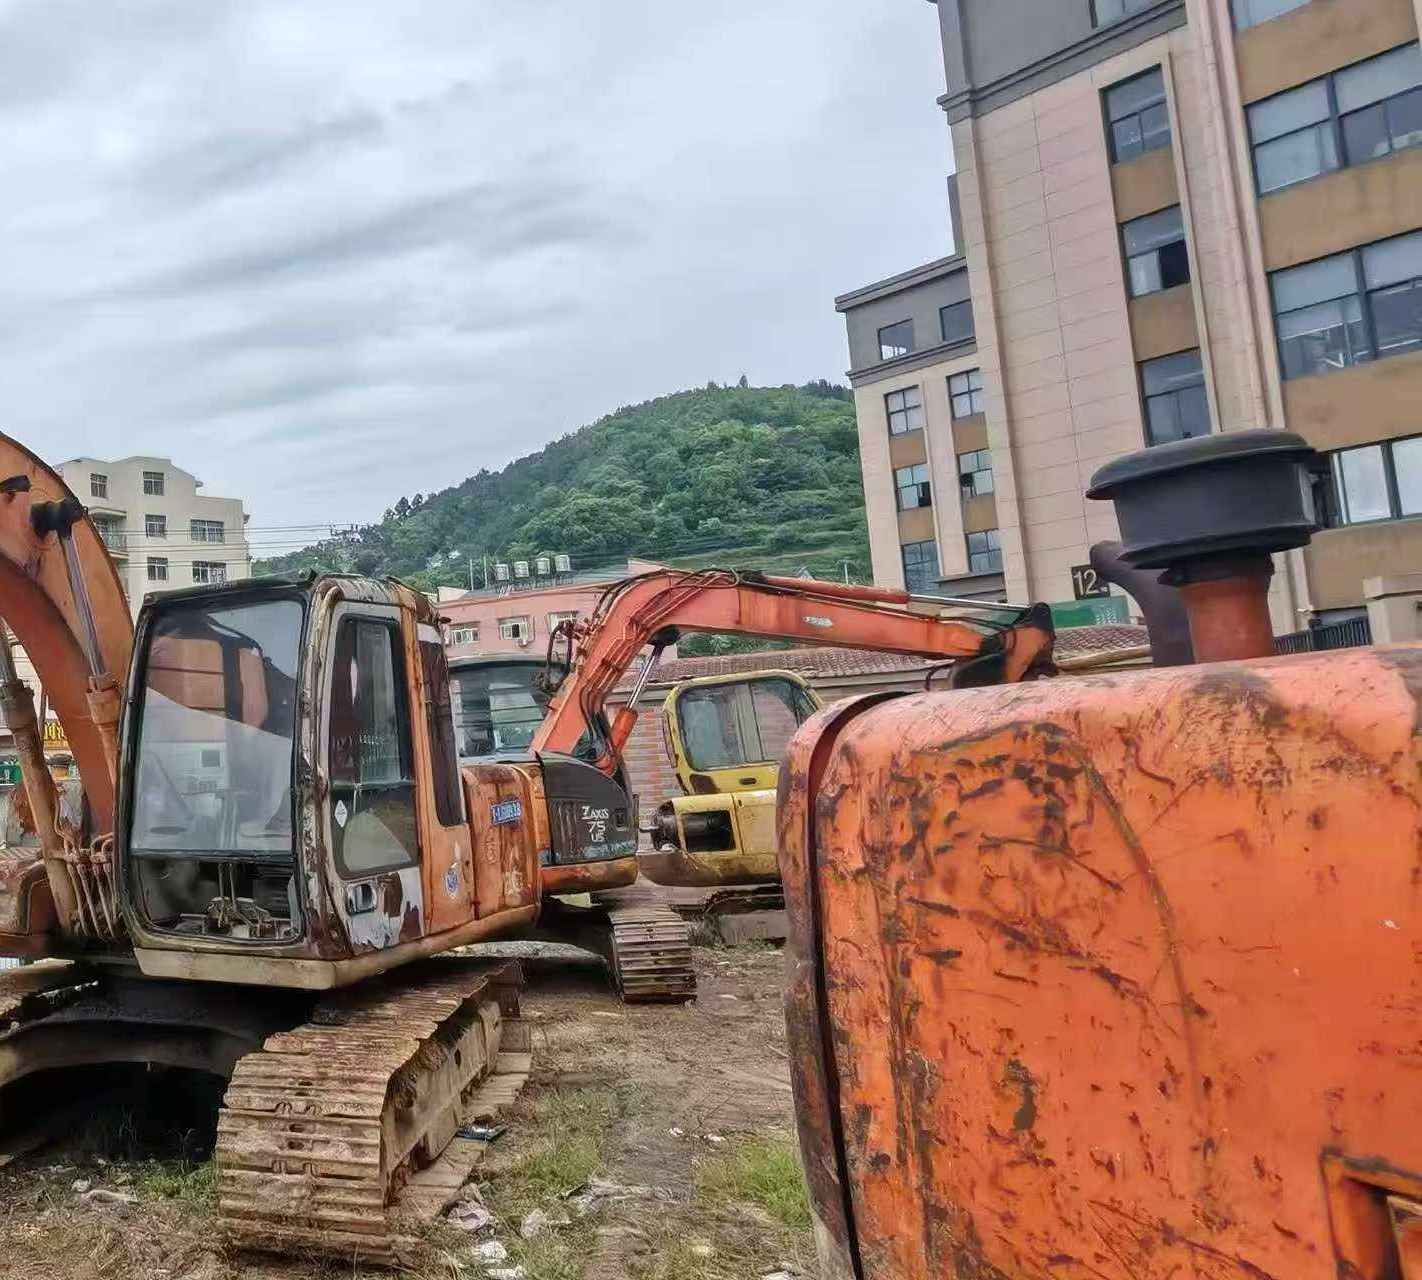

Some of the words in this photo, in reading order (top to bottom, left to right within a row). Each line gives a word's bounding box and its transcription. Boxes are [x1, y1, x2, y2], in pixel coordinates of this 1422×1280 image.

[1073, 568, 1108, 596] 12
[581, 805, 610, 820] ZAXIS
[586, 820, 606, 832] 75
[591, 832, 605, 843] US
